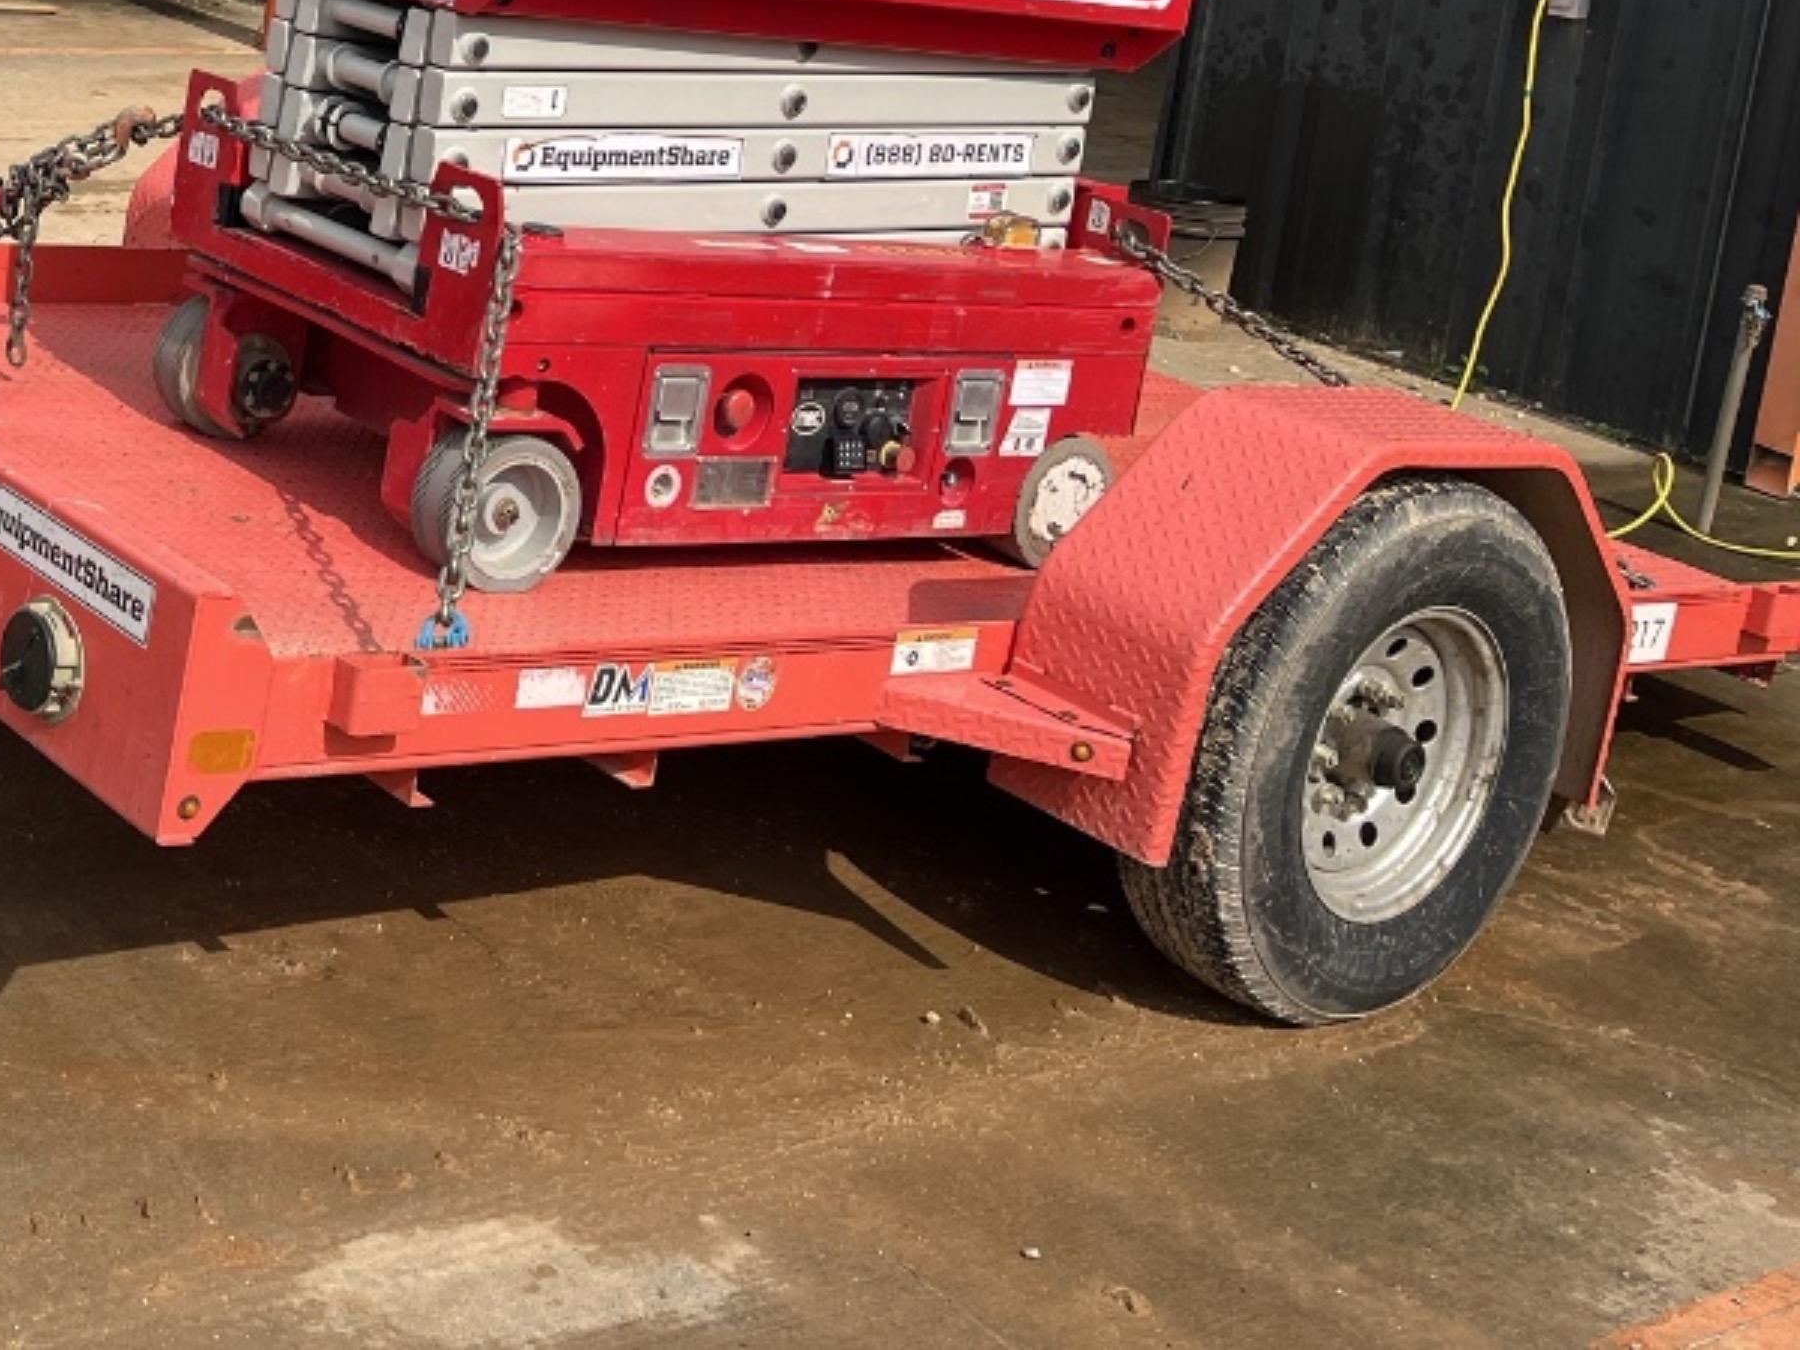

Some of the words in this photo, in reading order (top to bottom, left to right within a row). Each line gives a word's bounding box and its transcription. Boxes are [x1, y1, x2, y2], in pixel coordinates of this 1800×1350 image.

[540, 146, 731, 171] EquipmentShare
[866, 143, 923, 165] (888)
[929, 143, 1025, 164] 80-RENTS
